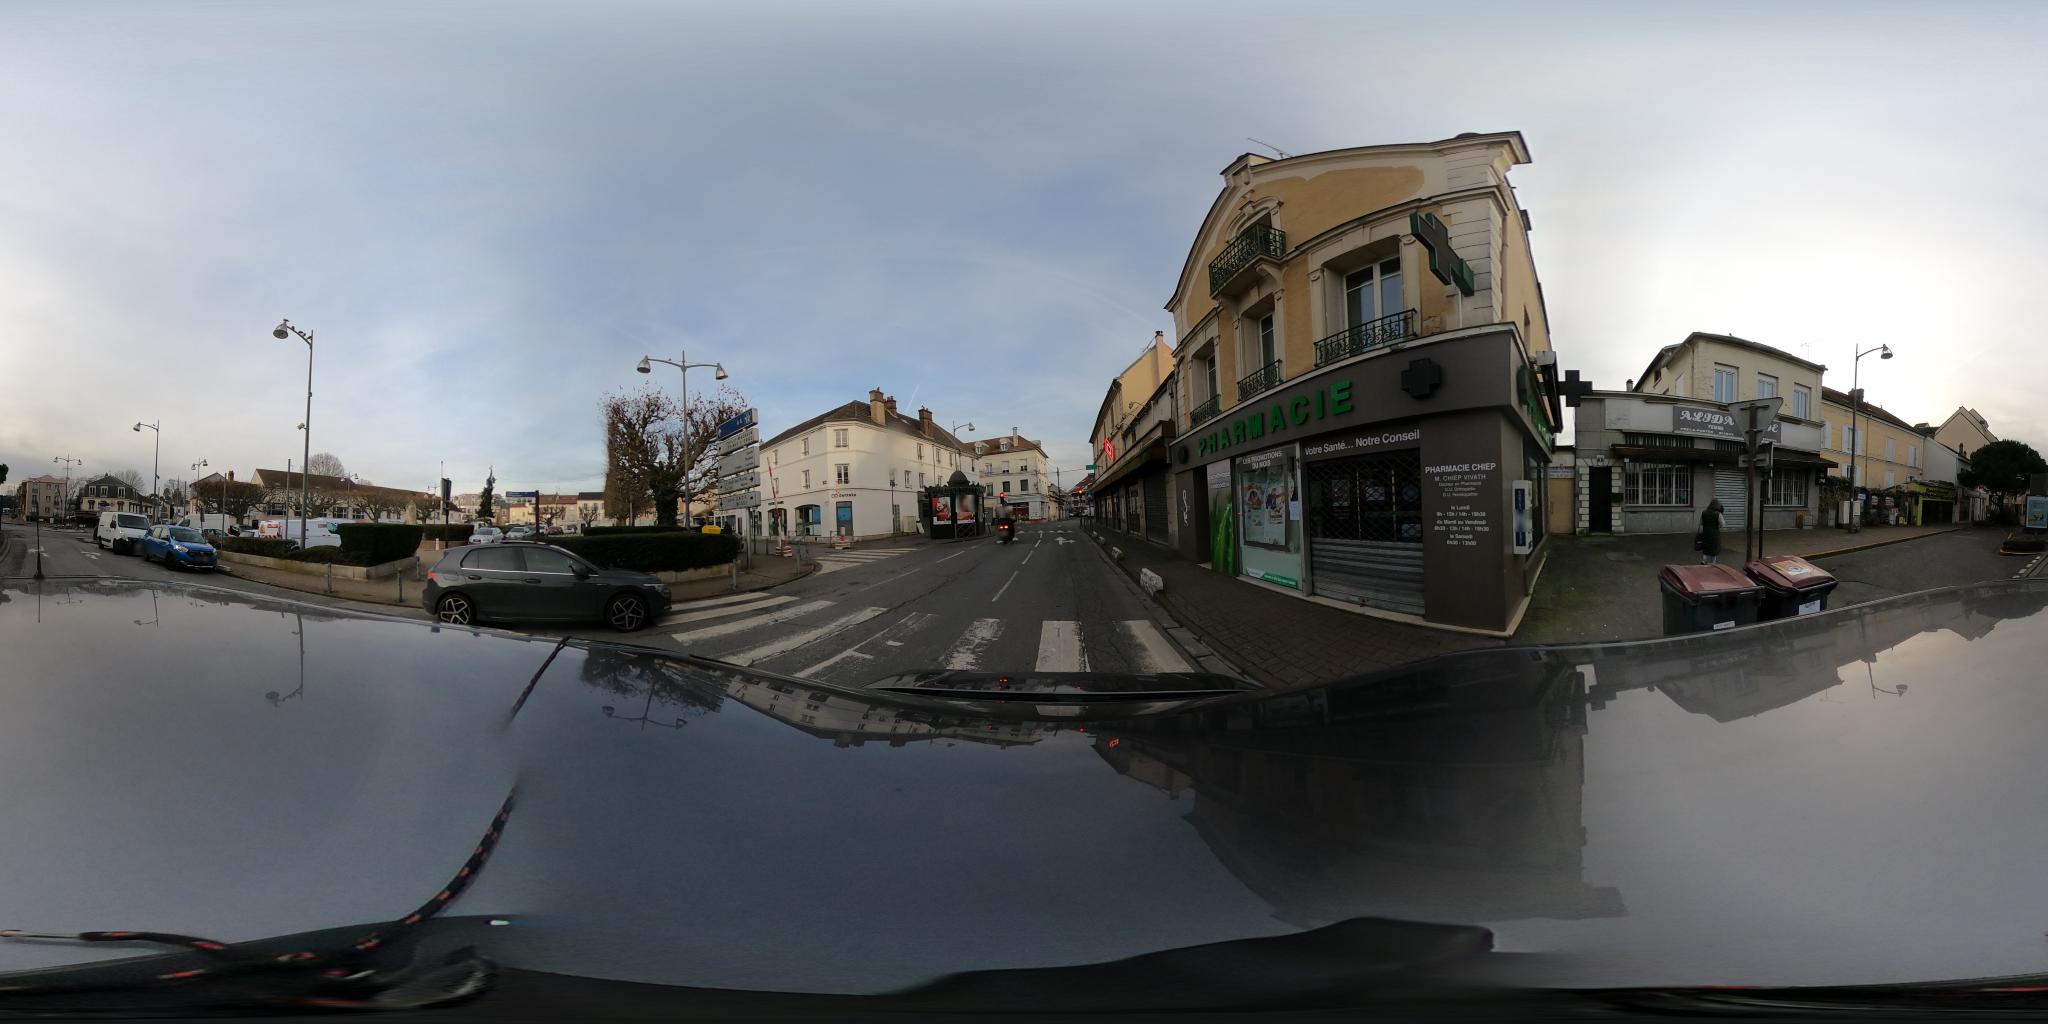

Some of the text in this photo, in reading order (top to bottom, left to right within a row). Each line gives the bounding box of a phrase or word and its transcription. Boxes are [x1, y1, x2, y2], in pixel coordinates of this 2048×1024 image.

[1197, 379, 1355, 456] PHARMACIE
[1680, 410, 1735, 426] ALIDA
[1304, 446, 1322, 456] Votre
[1355, 436, 1380, 448] Notre
[1382, 429, 1420, 444] Conseil
[1251, 450, 1283, 464] PROMOTIONS
[1251, 459, 1271, 469] DU MOIS
[1425, 462, 1496, 473] PHARMACIE CHIEP
